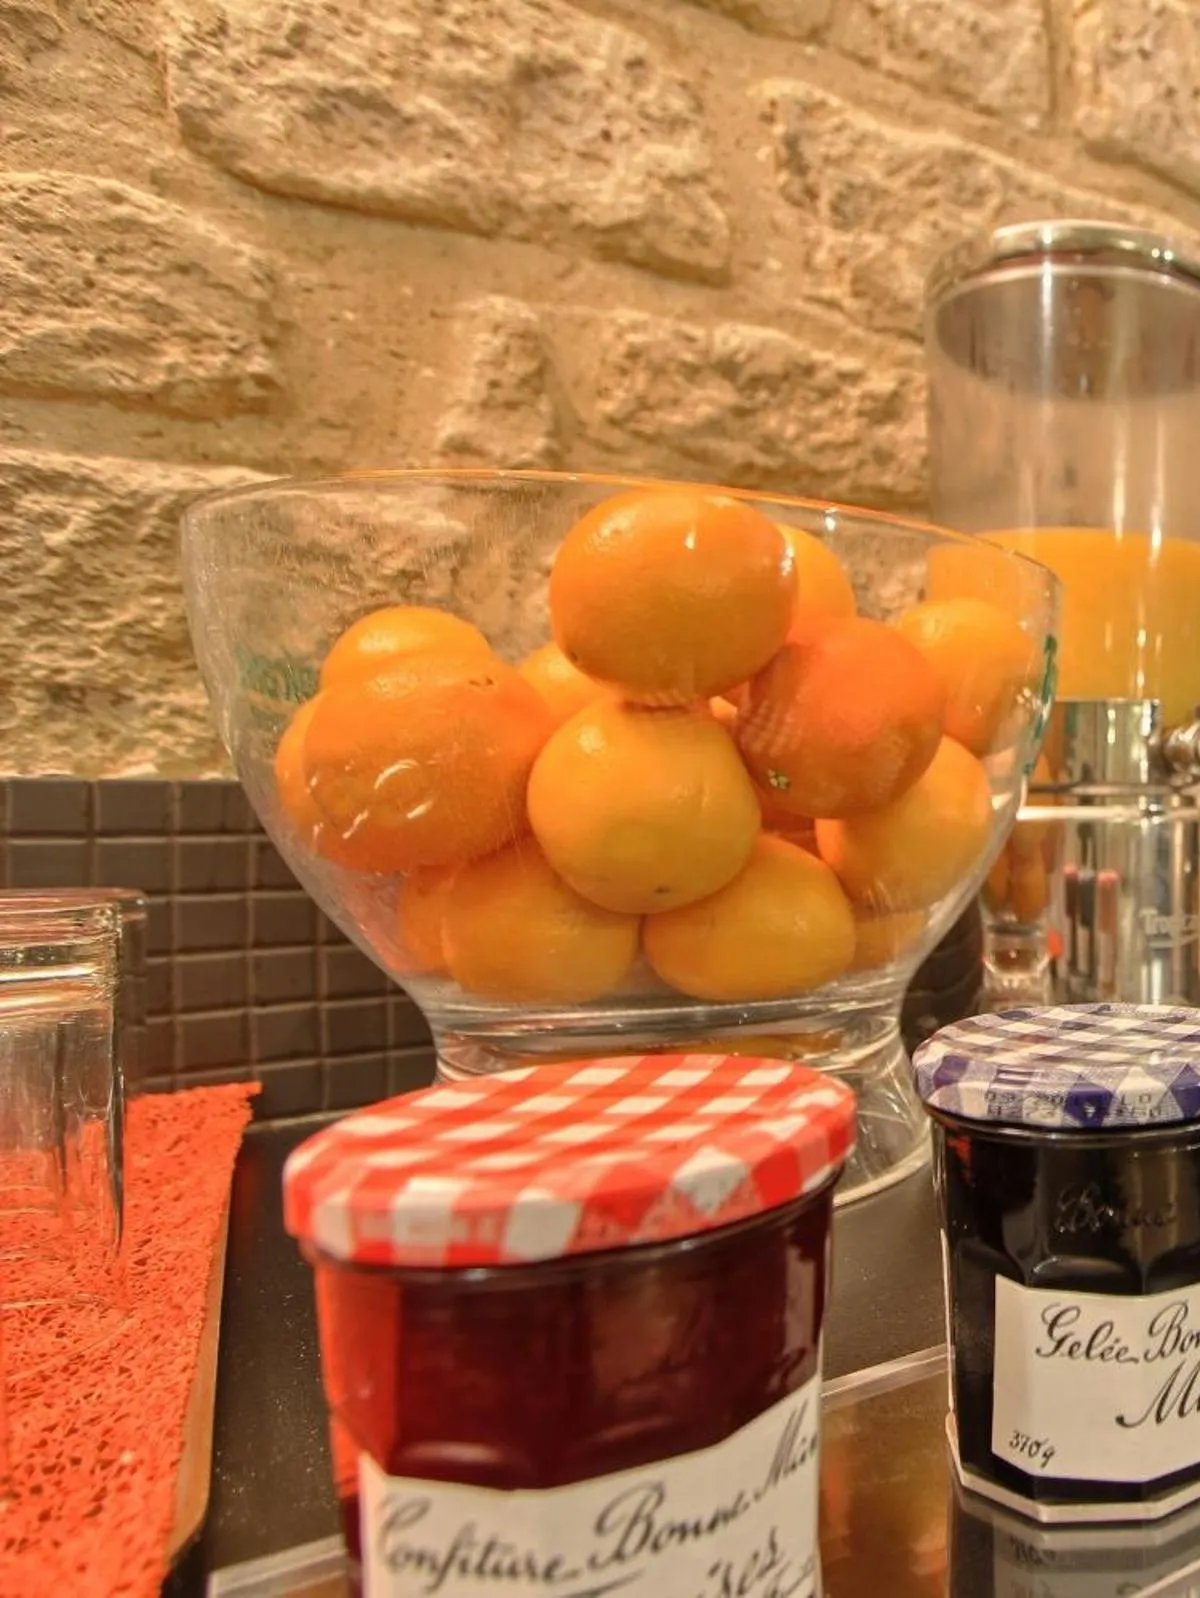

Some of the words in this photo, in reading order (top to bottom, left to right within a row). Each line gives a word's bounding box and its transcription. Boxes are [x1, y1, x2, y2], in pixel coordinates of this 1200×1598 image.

[1036, 1303, 1140, 1364] Gelée
[380, 1495, 582, 1594] Confiture
[587, 1480, 750, 1566] Bonne
